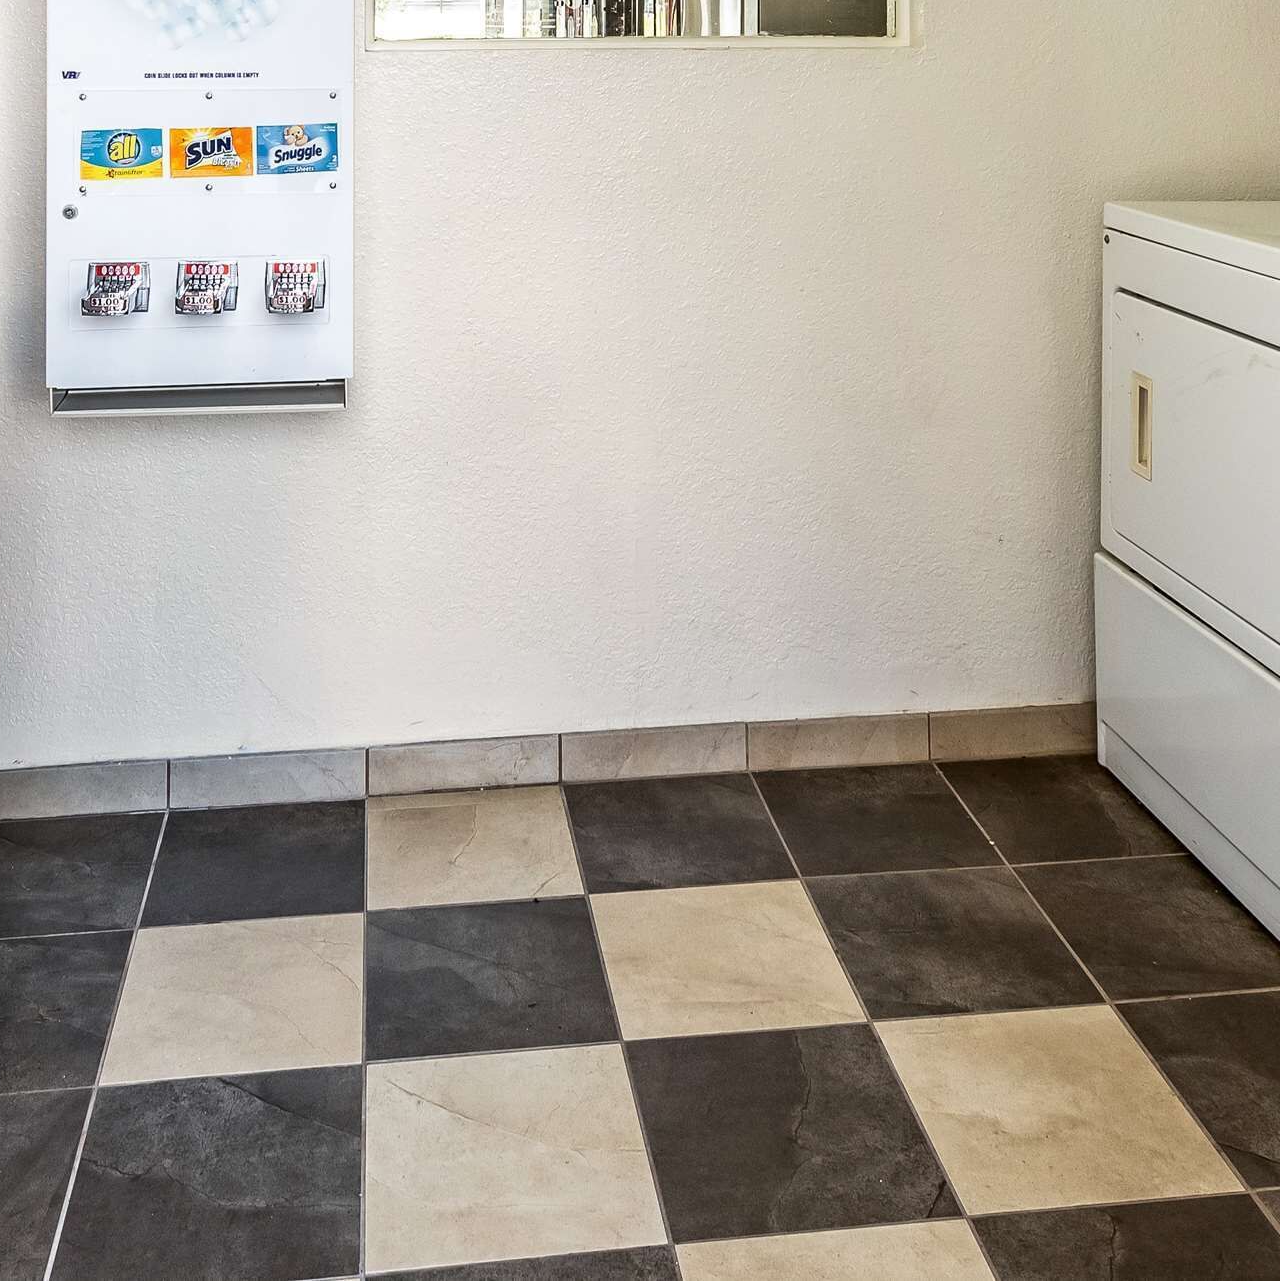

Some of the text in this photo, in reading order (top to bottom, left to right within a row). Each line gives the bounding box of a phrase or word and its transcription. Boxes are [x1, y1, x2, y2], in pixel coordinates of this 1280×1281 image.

[109, 134, 137, 162] all
[186, 136, 232, 167] SUN
[274, 144, 323, 164] Snuggle
